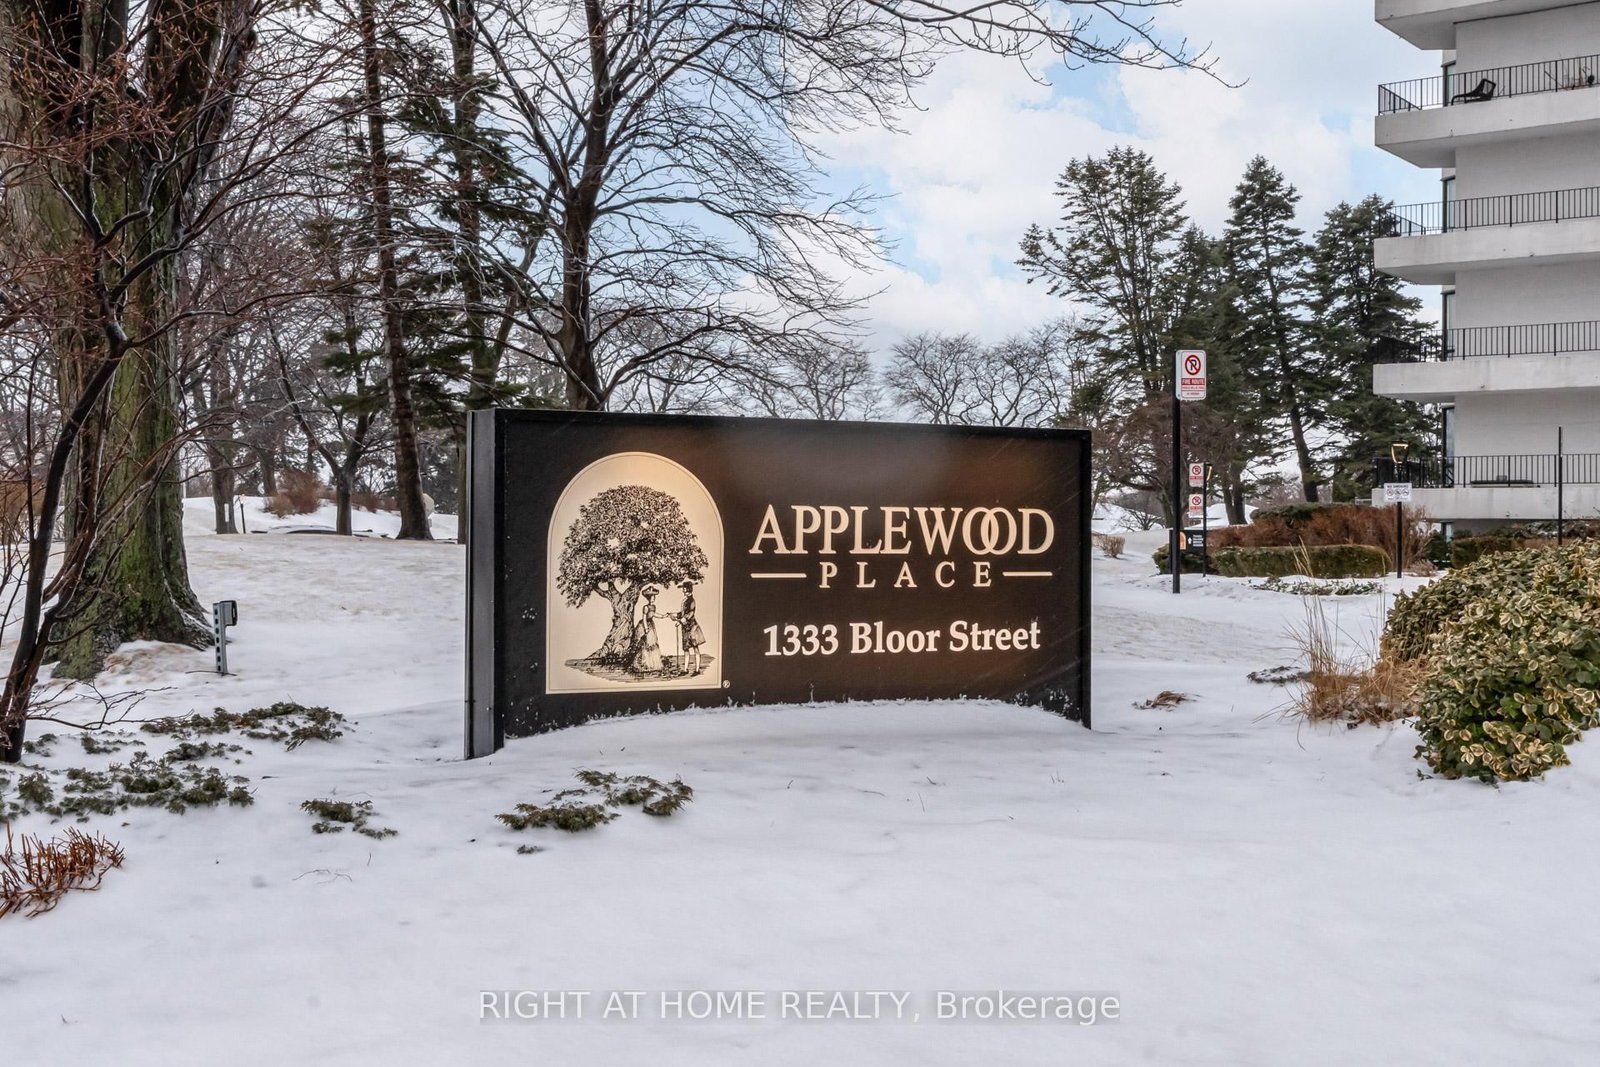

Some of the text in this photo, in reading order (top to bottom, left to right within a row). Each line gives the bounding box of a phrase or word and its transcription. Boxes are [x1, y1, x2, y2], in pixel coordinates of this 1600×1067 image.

[748, 503, 1055, 555] APPLEWOOD
[818, 561, 992, 588] PLACE
[763, 620, 1041, 656] 1333 Bloor Street
